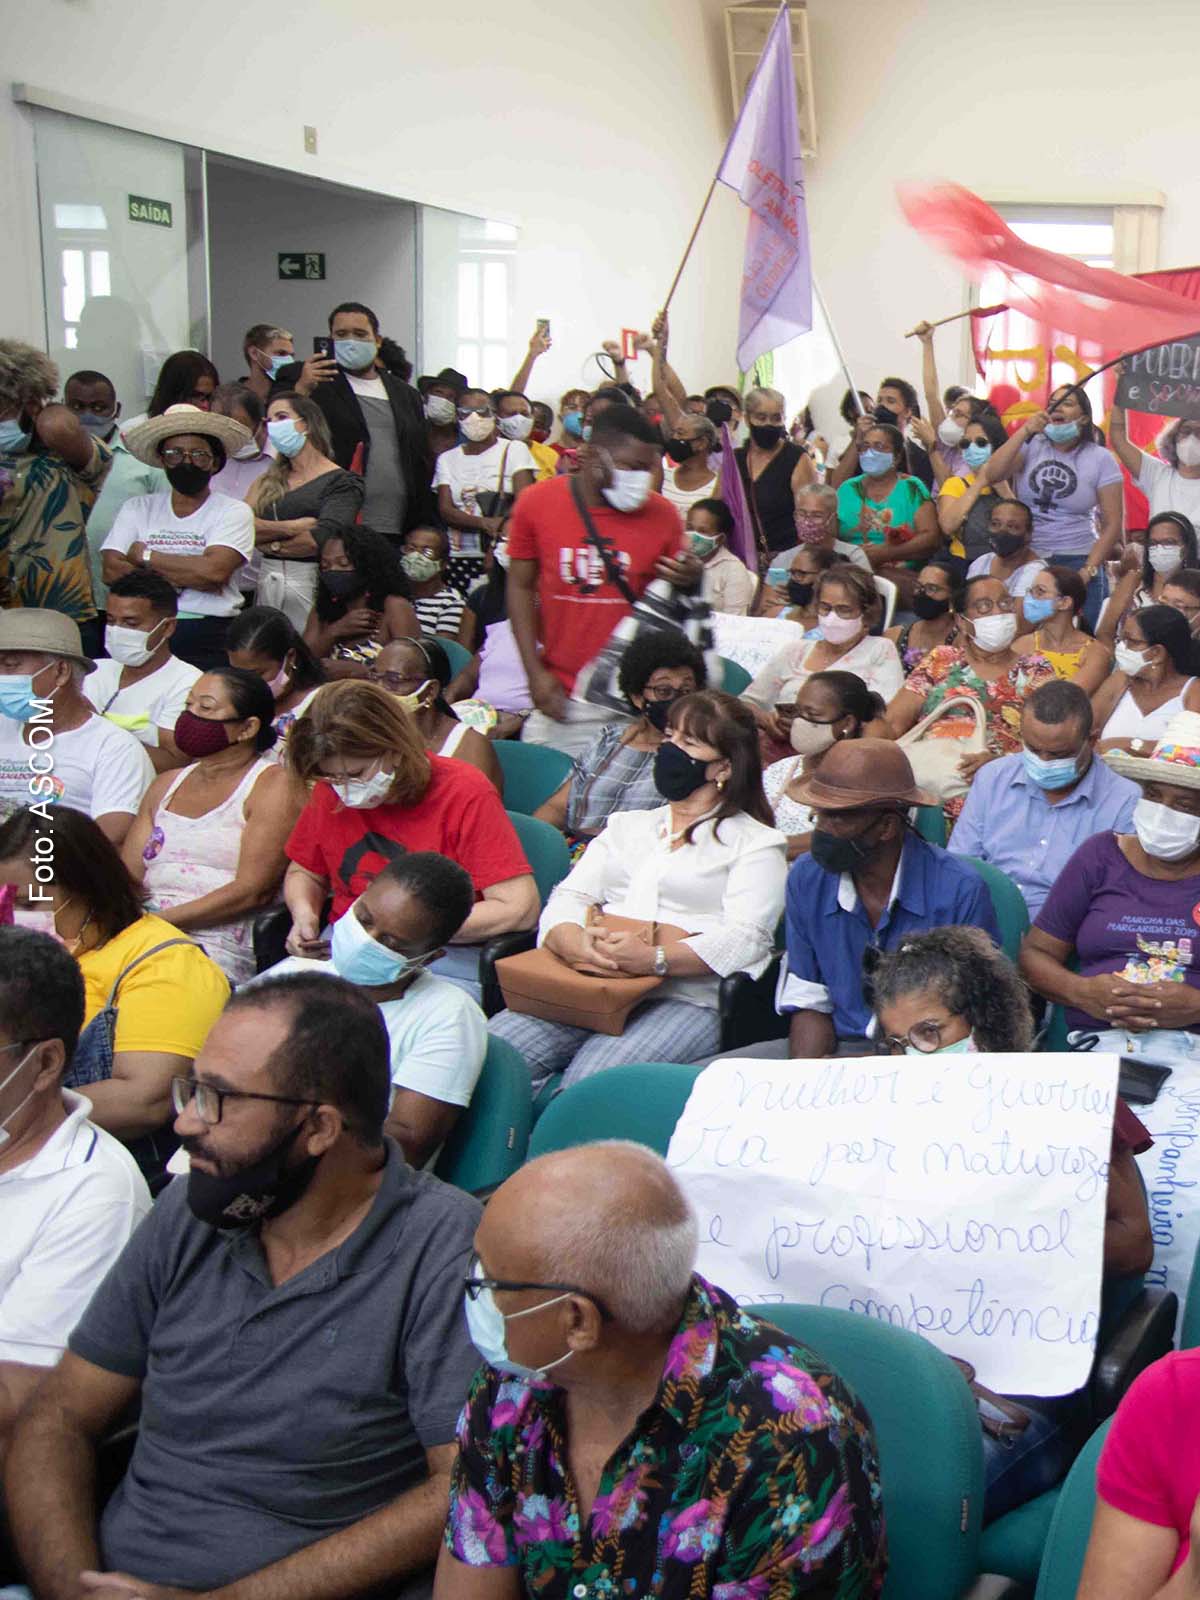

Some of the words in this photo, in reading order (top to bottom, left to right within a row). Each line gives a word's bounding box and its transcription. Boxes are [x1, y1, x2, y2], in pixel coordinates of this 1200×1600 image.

[131, 202, 171, 224] SAÍDA
[1128, 385, 1141, 400] e
[1121, 915, 1163, 925] MARCHA
[1107, 922, 1172, 934] MARGARIDAS
[699, 1214, 734, 1248] e
[765, 1207, 1076, 1281] profissional
